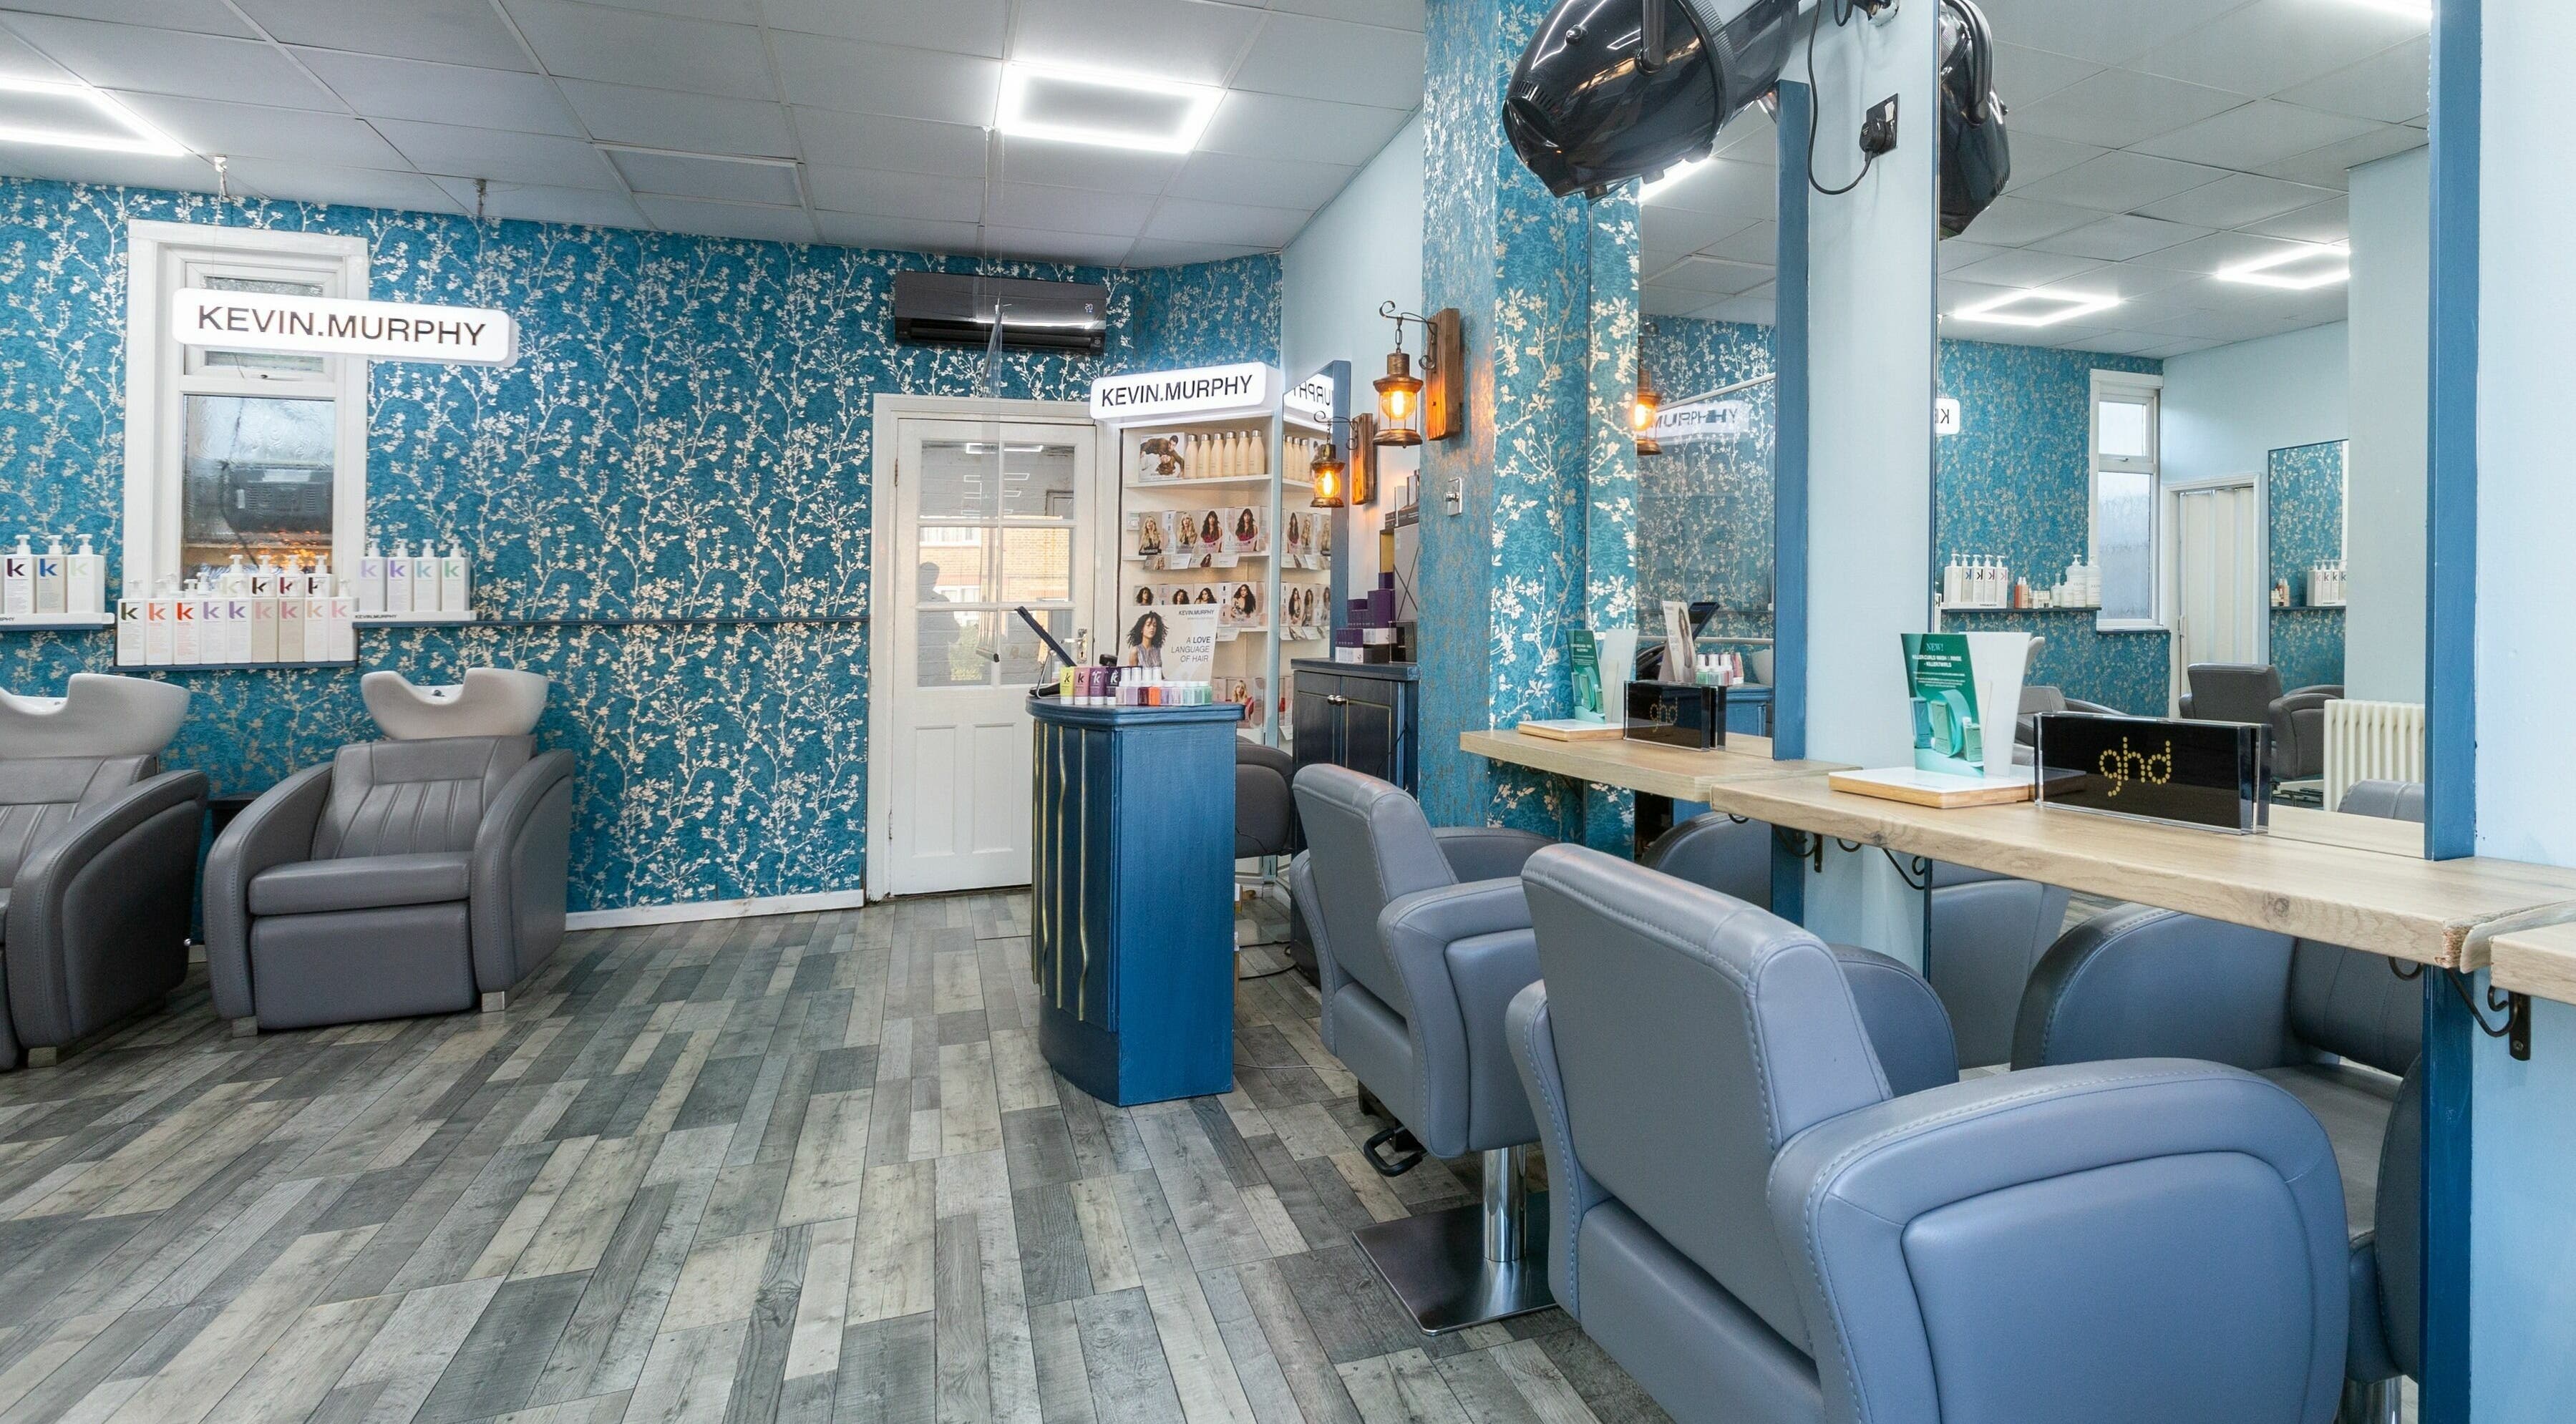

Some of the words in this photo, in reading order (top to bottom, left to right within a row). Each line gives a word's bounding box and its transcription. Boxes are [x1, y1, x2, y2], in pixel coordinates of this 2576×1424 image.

[198, 305, 486, 346] KEVIN.MURPHY
[1102, 374, 1253, 406] KEVIN.MURPHY
[1926, 643, 1943, 651] NEW!
[1650, 695, 1678, 733] ghd
[2099, 736, 2172, 797] ghd
